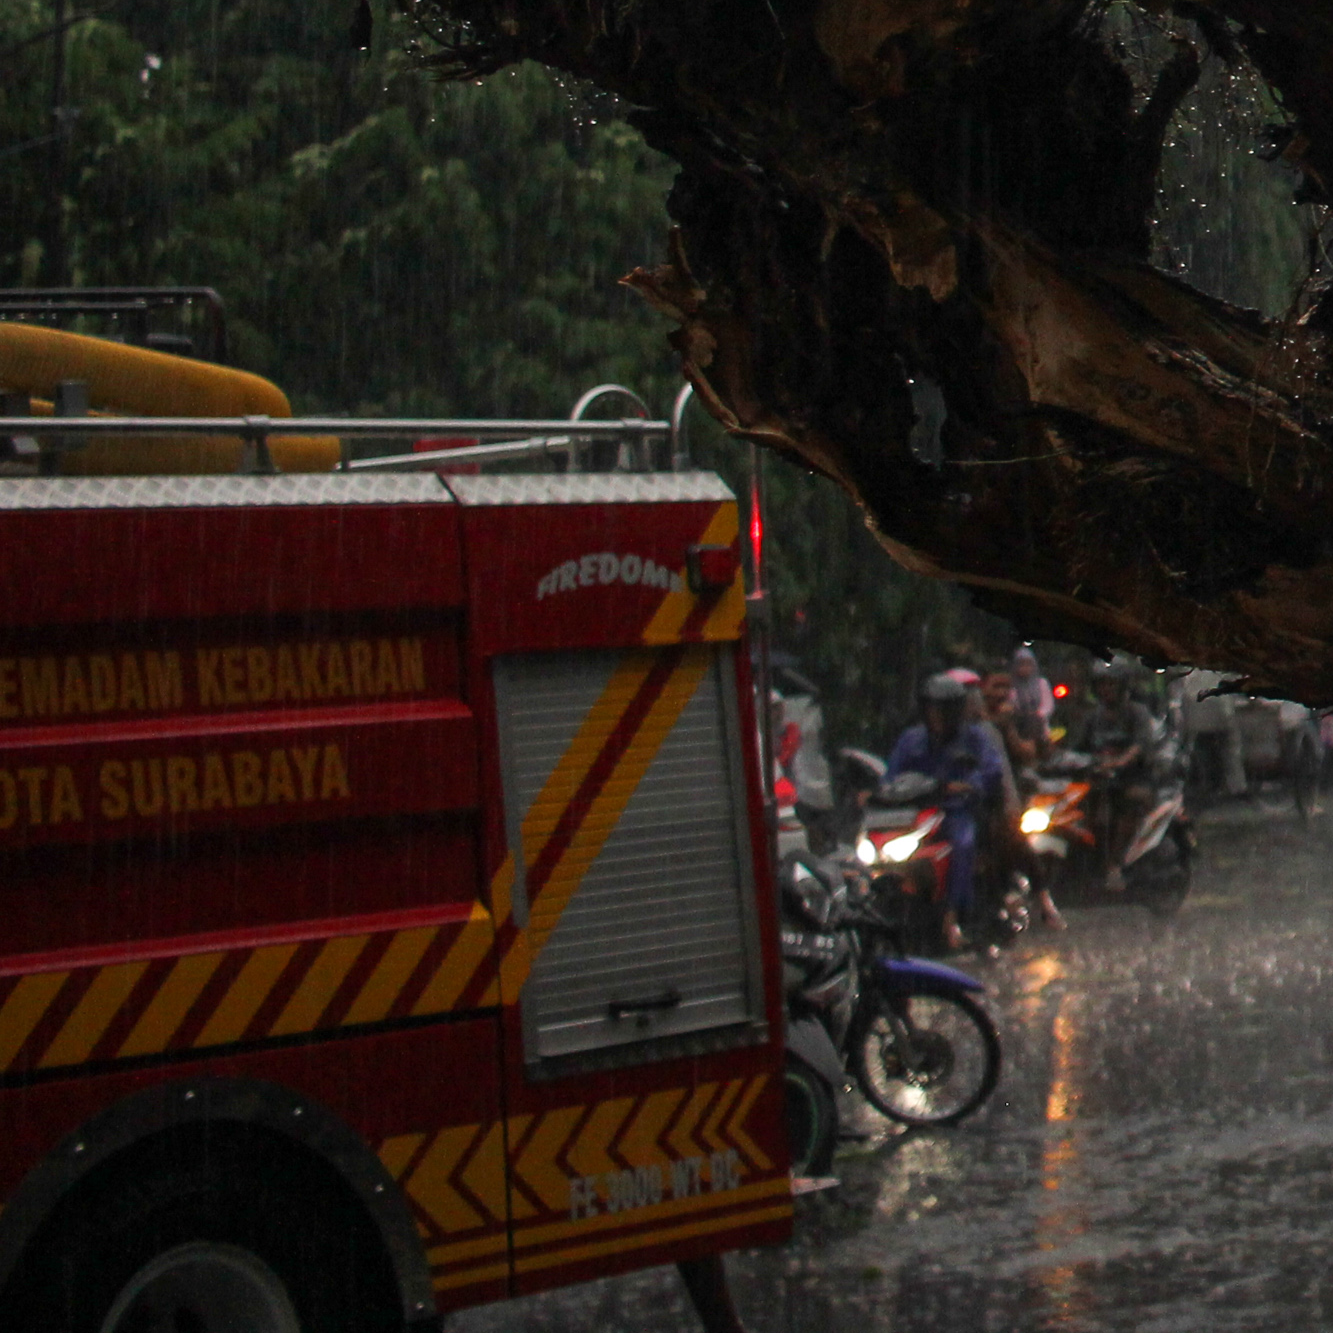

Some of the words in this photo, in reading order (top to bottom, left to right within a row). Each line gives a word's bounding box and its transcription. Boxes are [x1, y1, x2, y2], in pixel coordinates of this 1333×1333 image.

[197, 637, 426, 706] KEBAKARAN
[101, 742, 350, 819] SURABAYA
[569, 1172, 599, 1222] FE
